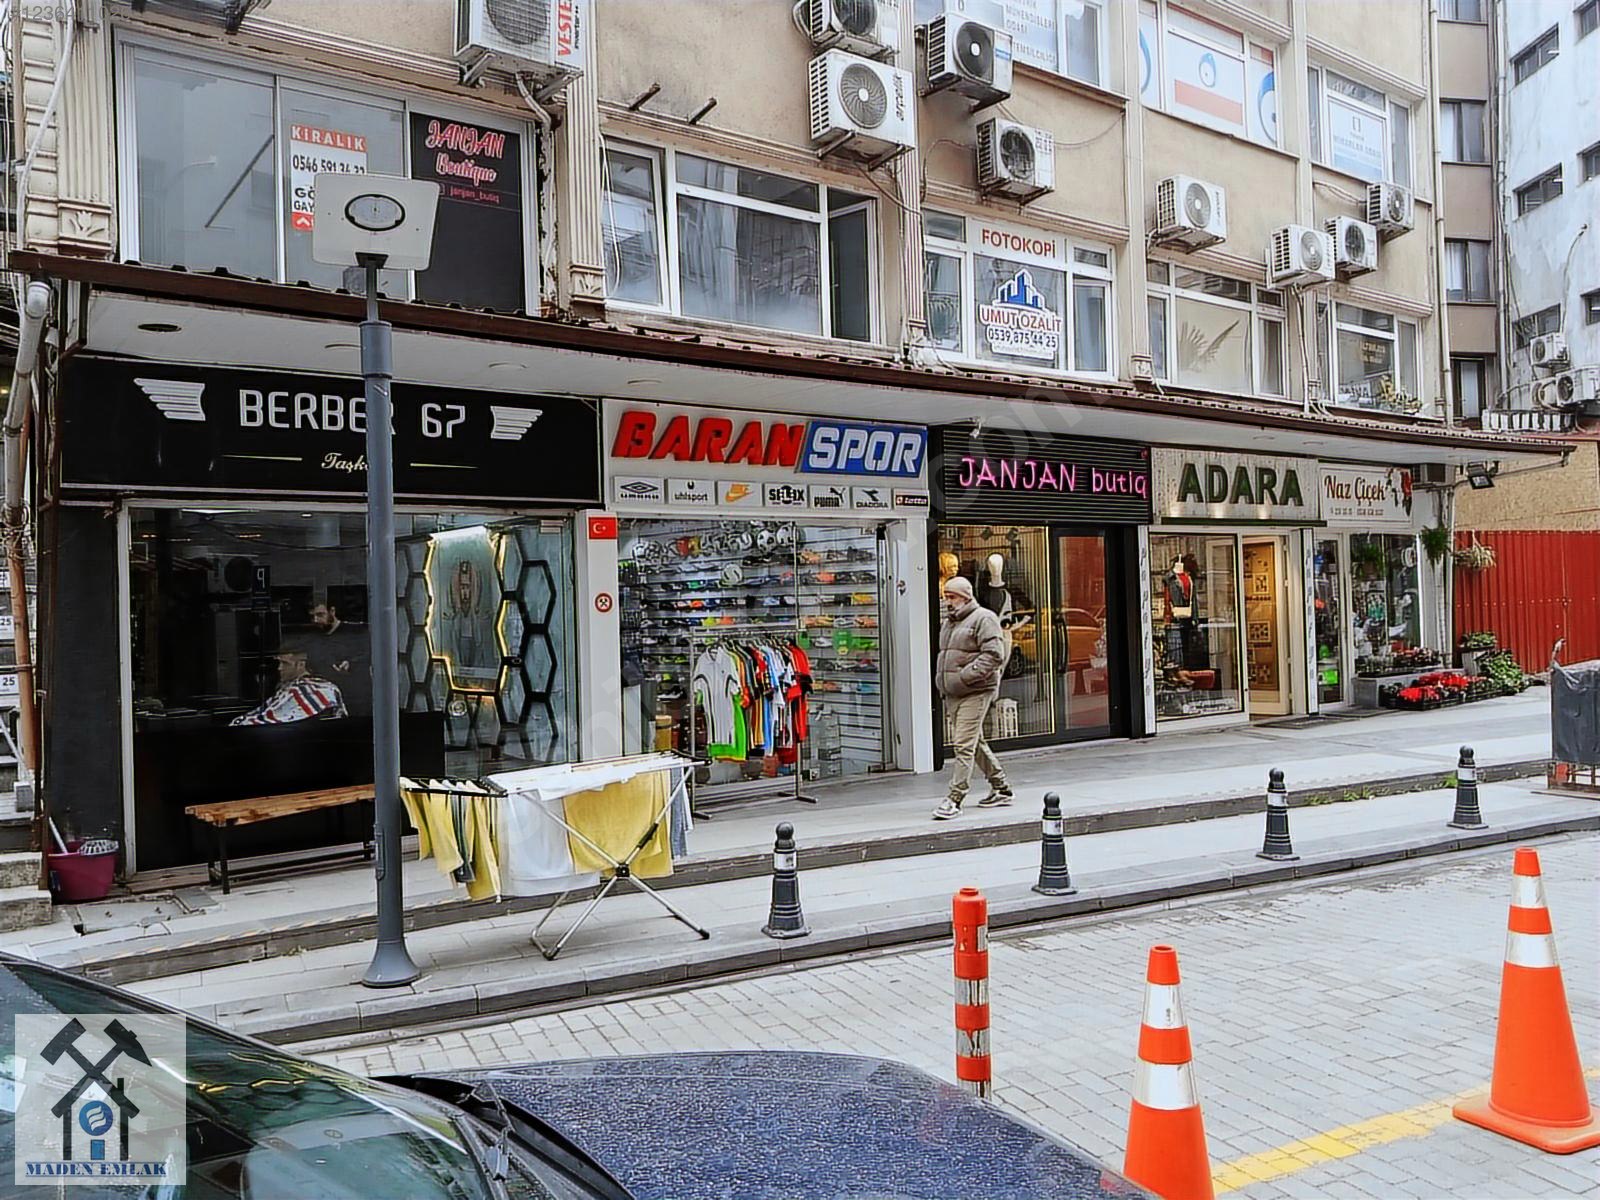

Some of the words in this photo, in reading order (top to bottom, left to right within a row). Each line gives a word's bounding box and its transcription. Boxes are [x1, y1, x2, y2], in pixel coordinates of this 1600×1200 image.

[557, 0, 572, 56] VESTE
[292, 154, 318, 173] 0546
[982, 228, 1056, 258] FOTOKOPİ
[981, 306, 1018, 326] UMUT
[1046, 335, 1057, 348] 25
[239, 388, 396, 435] BERBE
[421, 402, 465, 438] 67
[611, 410, 806, 467] BARAN
[808, 426, 923, 473] SPOR
[321, 452, 368, 473] Taşk
[958, 457, 1076, 492] JANJAN
[1176, 462, 1304, 507] ADARA
[1324, 475, 1352, 499] Naz
[1354, 476, 1386, 506] Çiçek
[814, 496, 840, 508] PUMA
[2, 676, 16, 686] 25
